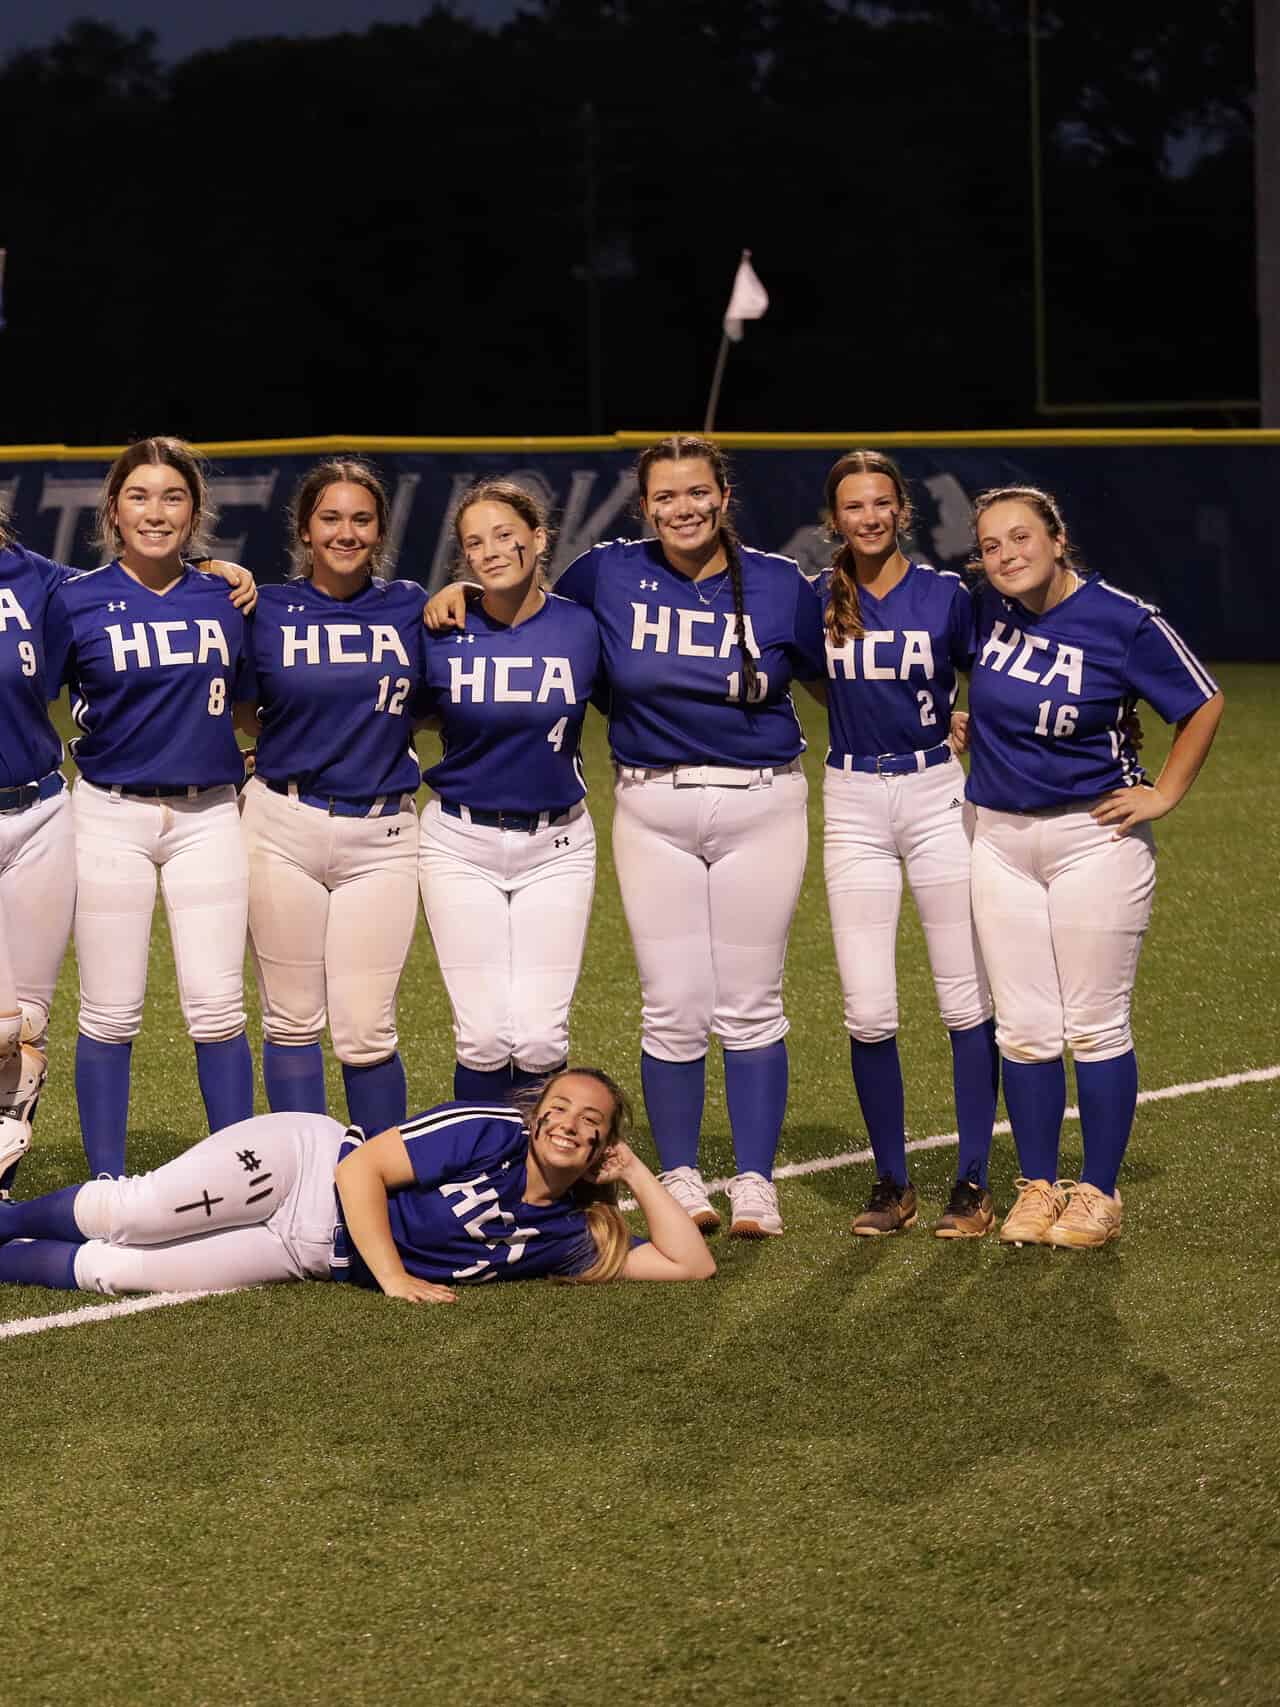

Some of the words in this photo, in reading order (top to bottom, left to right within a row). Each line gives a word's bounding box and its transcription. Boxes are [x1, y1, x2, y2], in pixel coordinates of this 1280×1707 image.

[104, 619, 230, 672] HCA
[279, 624, 410, 668] HCA
[630, 602, 761, 659] HCA
[17, 640, 37, 677] 9
[822, 627, 935, 680] HCA
[979, 620, 1084, 695] HCA
[207, 677, 226, 716] 8
[374, 675, 411, 715] 12
[447, 656, 576, 704] HCA
[724, 671, 769, 704] 10
[916, 689, 937, 727] 2
[1034, 699, 1080, 737] 16
[547, 715, 569, 752] 4
[438, 1172, 540, 1264] HCA
